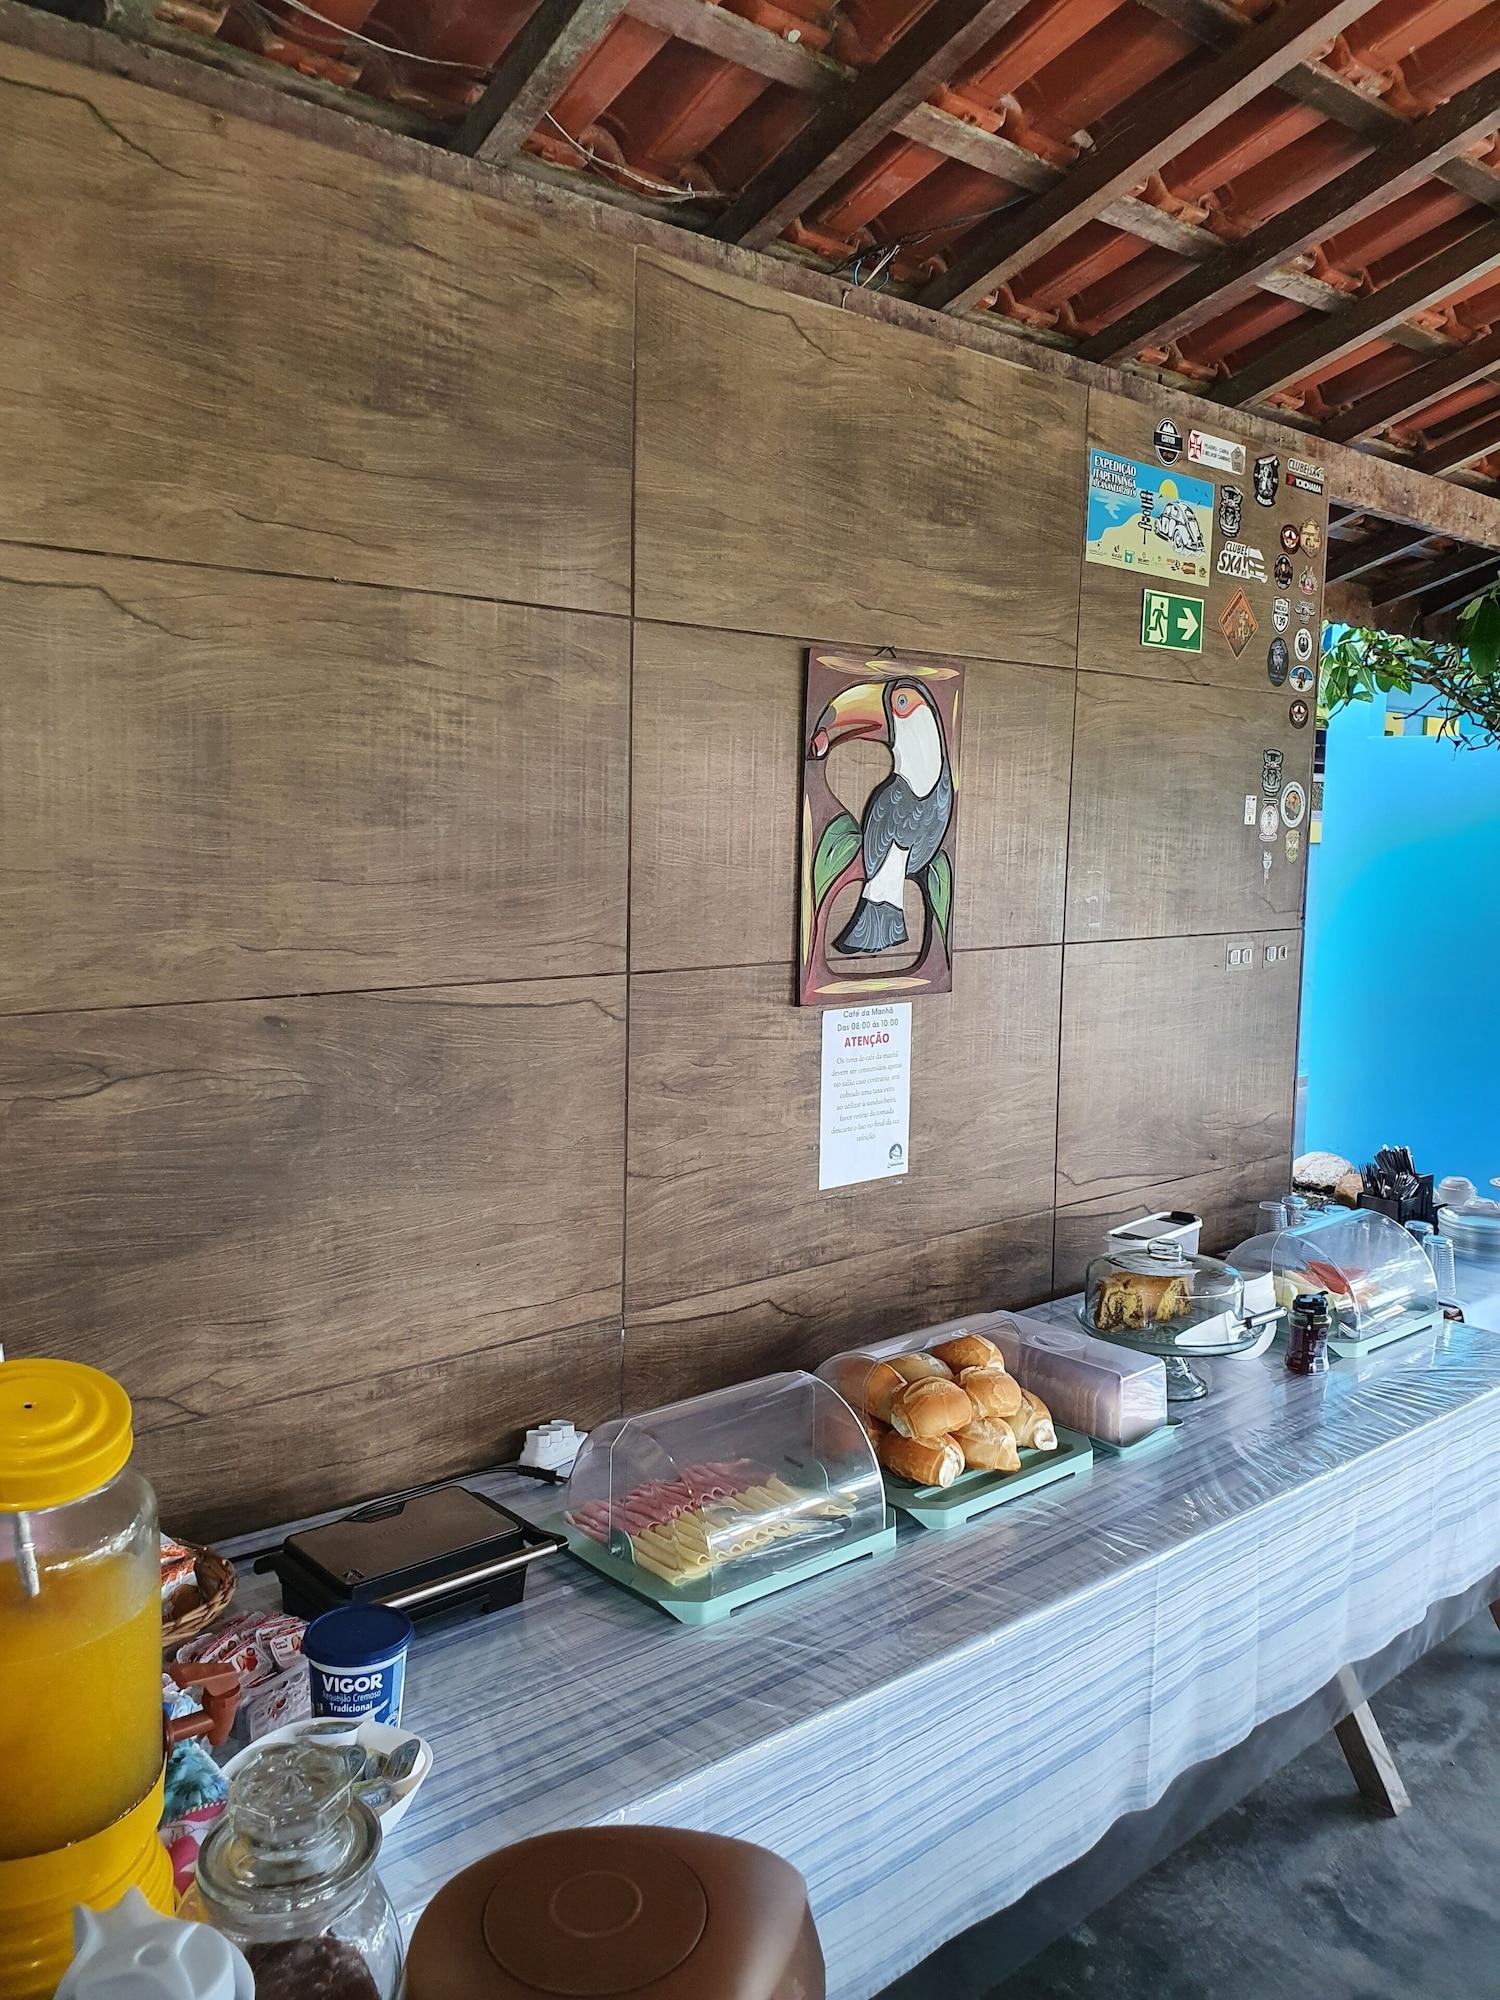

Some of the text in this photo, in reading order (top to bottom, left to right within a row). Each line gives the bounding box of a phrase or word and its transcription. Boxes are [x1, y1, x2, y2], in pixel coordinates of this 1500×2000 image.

[1094, 455, 1137, 477] EXPEDIÇÃO
[1289, 459, 1308, 475] CLUBE
[1093, 468, 1137, 489] ITAPETININGA
[1295, 477, 1322, 494] YOKOHAMA
[1225, 541, 1245, 556] CLUBE
[843, 1006, 894, 1018] Café da Manhã
[837, 1023, 850, 1032] Das
[881, 1018, 899, 1027] 10:00
[844, 1031, 890, 1048] ATENÇÃO
[321, 1673, 384, 1694] VIGOR
[352, 1690, 382, 1703] Cremoso
[329, 1701, 373, 1713] Tradicional
